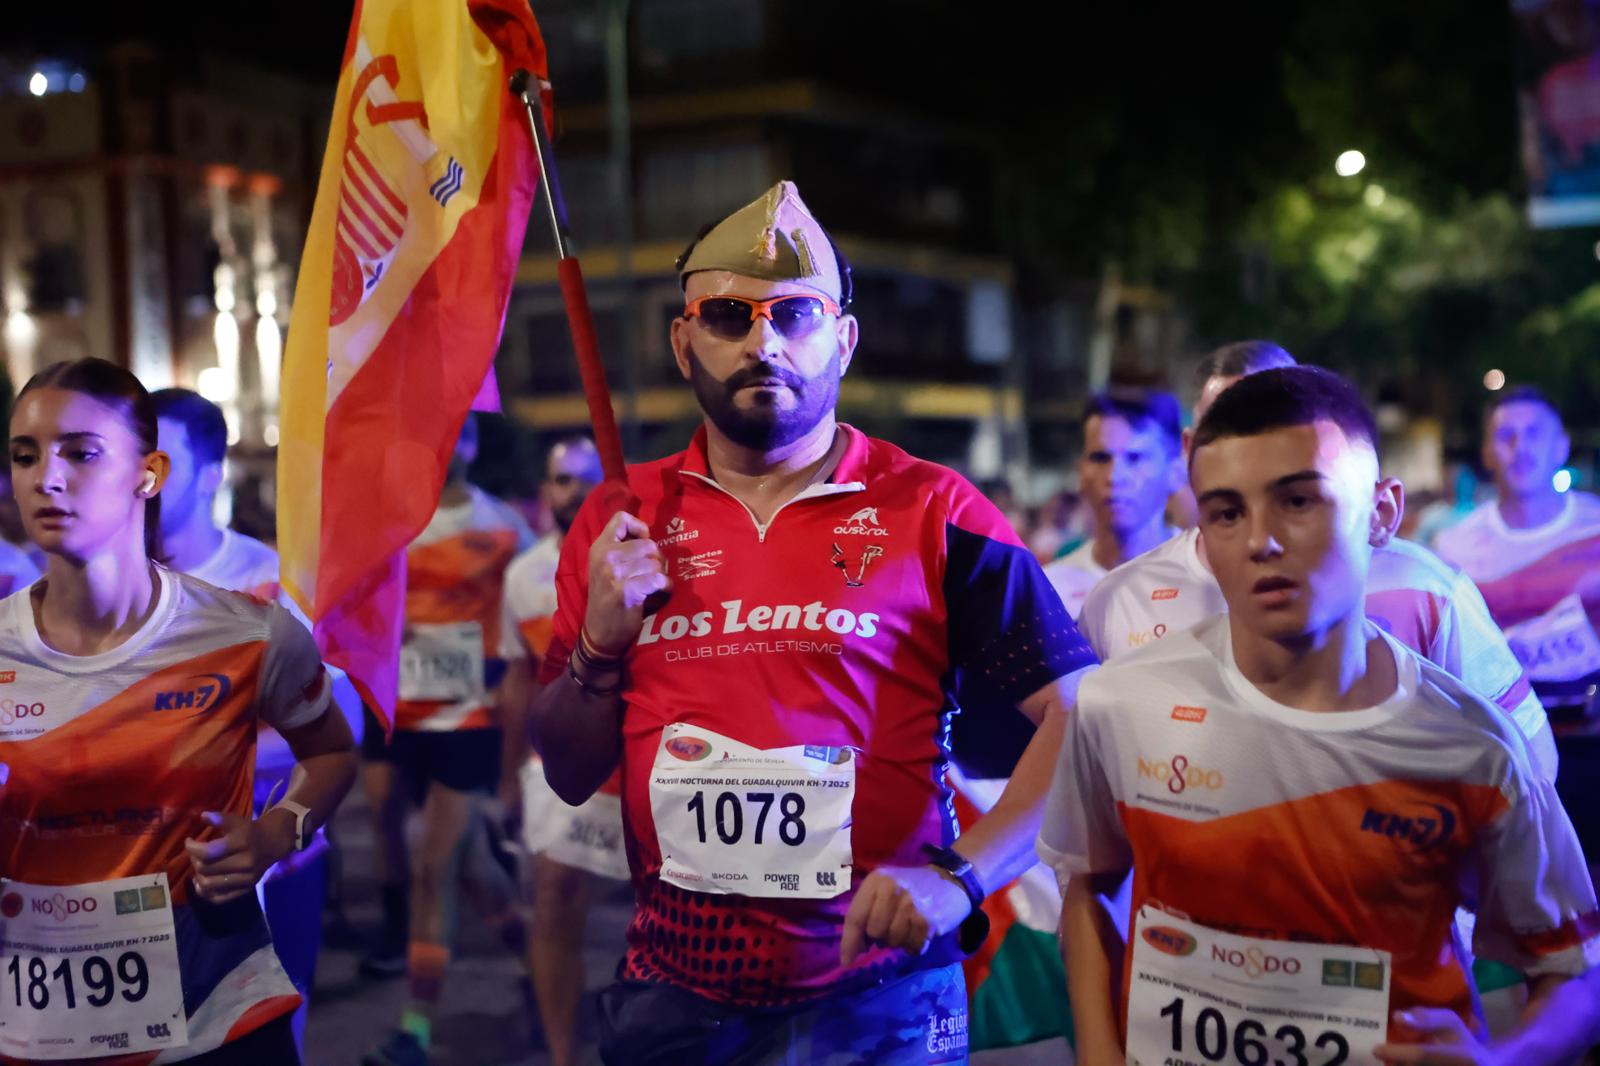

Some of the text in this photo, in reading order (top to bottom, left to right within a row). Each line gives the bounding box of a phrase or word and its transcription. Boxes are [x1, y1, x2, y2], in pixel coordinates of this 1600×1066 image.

[678, 550, 723, 564] Deportes
[684, 569, 716, 580] Sevilla
[636, 599, 880, 646] Los Lentos
[665, 640, 842, 662] CLUB DE ATLETISMO
[680, 777, 724, 785] NOCTURNA
[725, 778, 741, 786] DEL
[742, 778, 805, 787] GUADALQUIVIR
[828, 780, 850, 788] 2025
[687, 791, 806, 846] 1078
[764, 874, 800, 882] POWER
[780, 882, 800, 891] ADE
[8, 951, 149, 1010] 18199
[1160, 997, 1349, 1066] 10632
